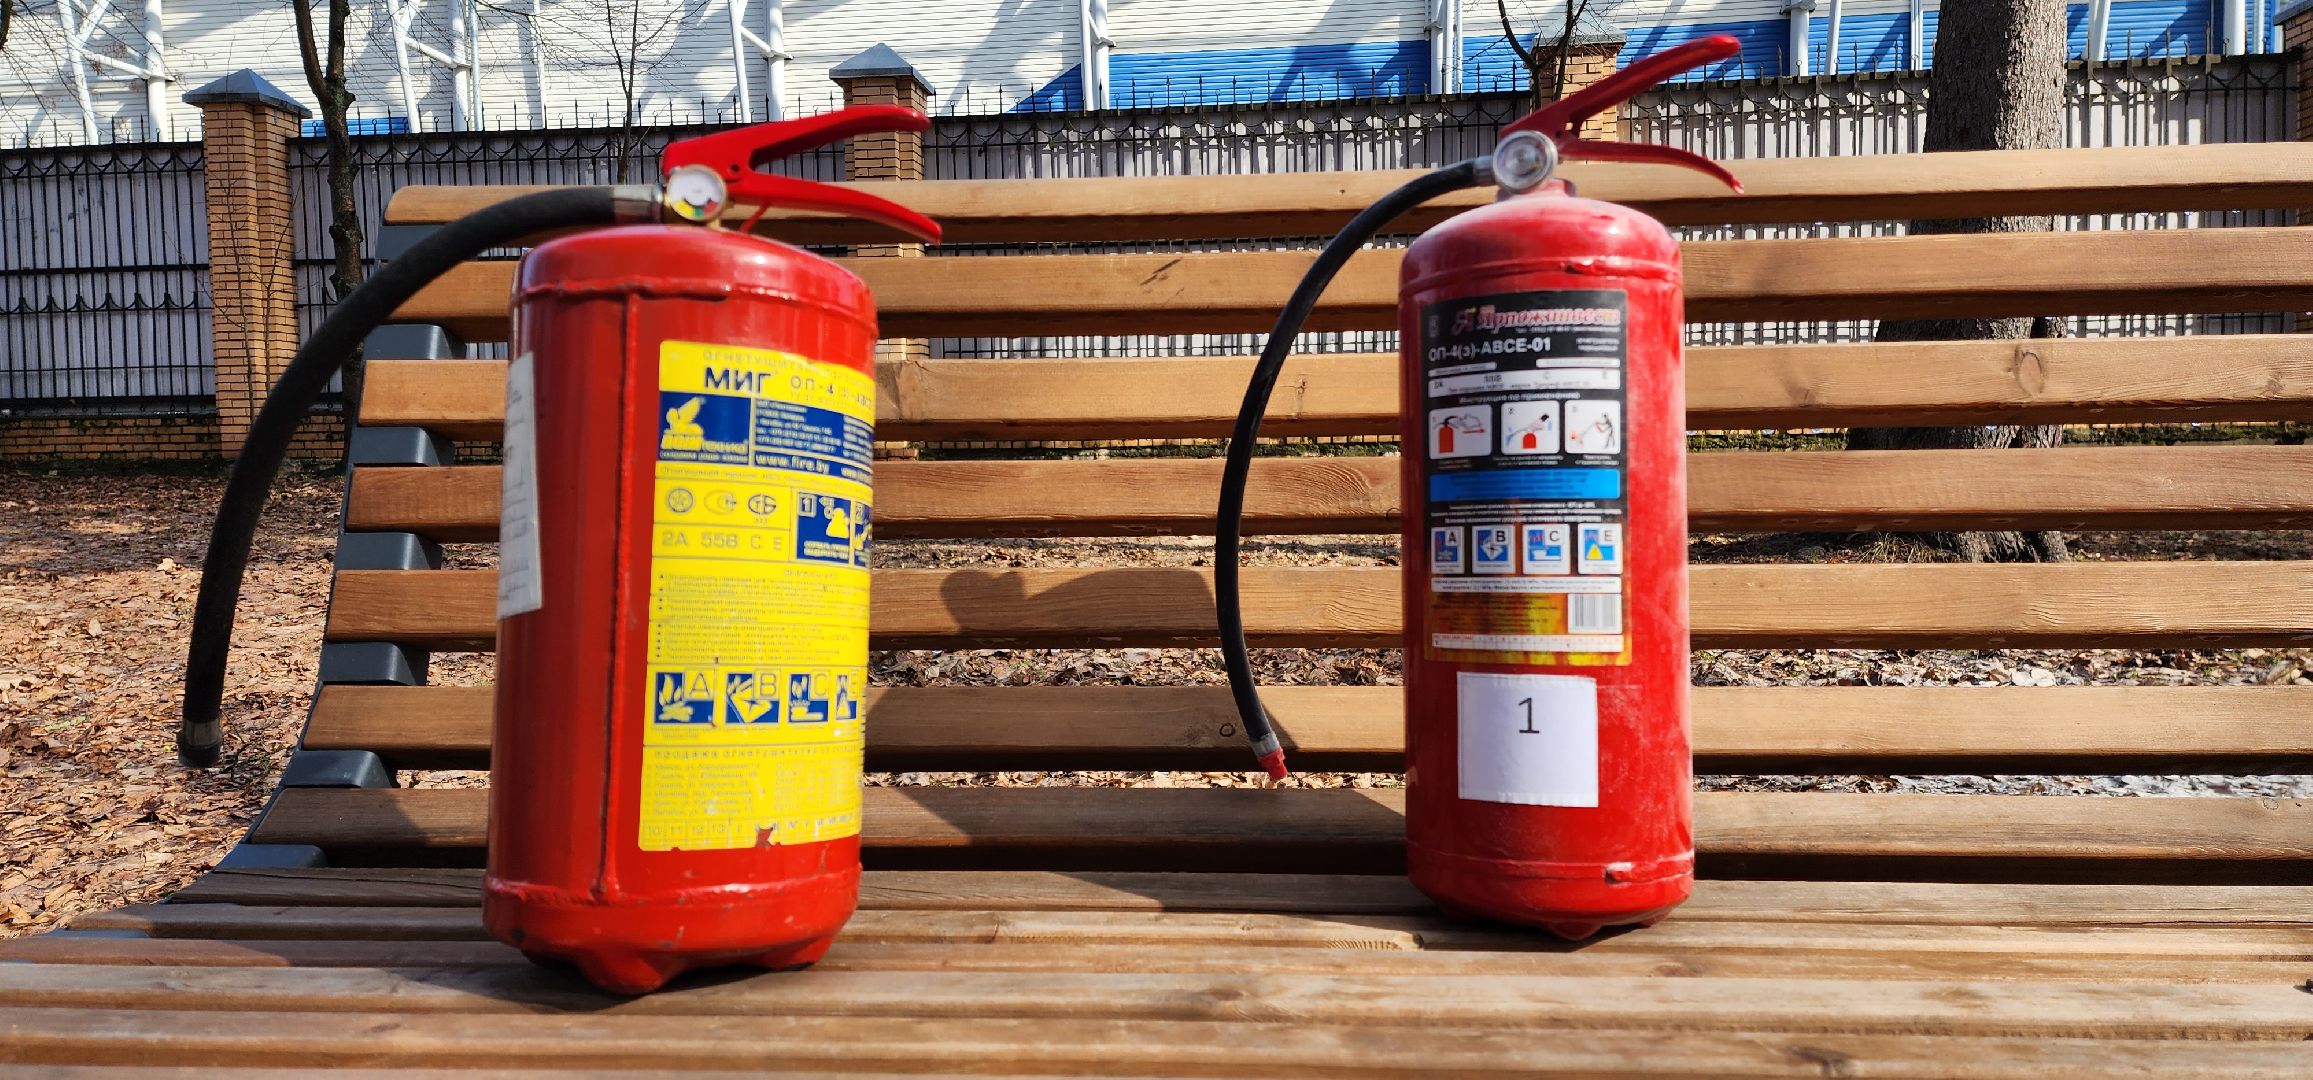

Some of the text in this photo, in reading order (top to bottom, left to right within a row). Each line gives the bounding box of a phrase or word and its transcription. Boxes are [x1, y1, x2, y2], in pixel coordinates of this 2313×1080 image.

[704, 366, 772, 394] МИГ
[754, 453, 830, 475] www.fire.by
[1447, 531, 1457, 543] A
[1495, 530, 1507, 543] B
[1549, 530, 1560, 543] C
[691, 673, 709, 697] A
[759, 673, 777, 697] B
[1518, 697, 1540, 734] 1
